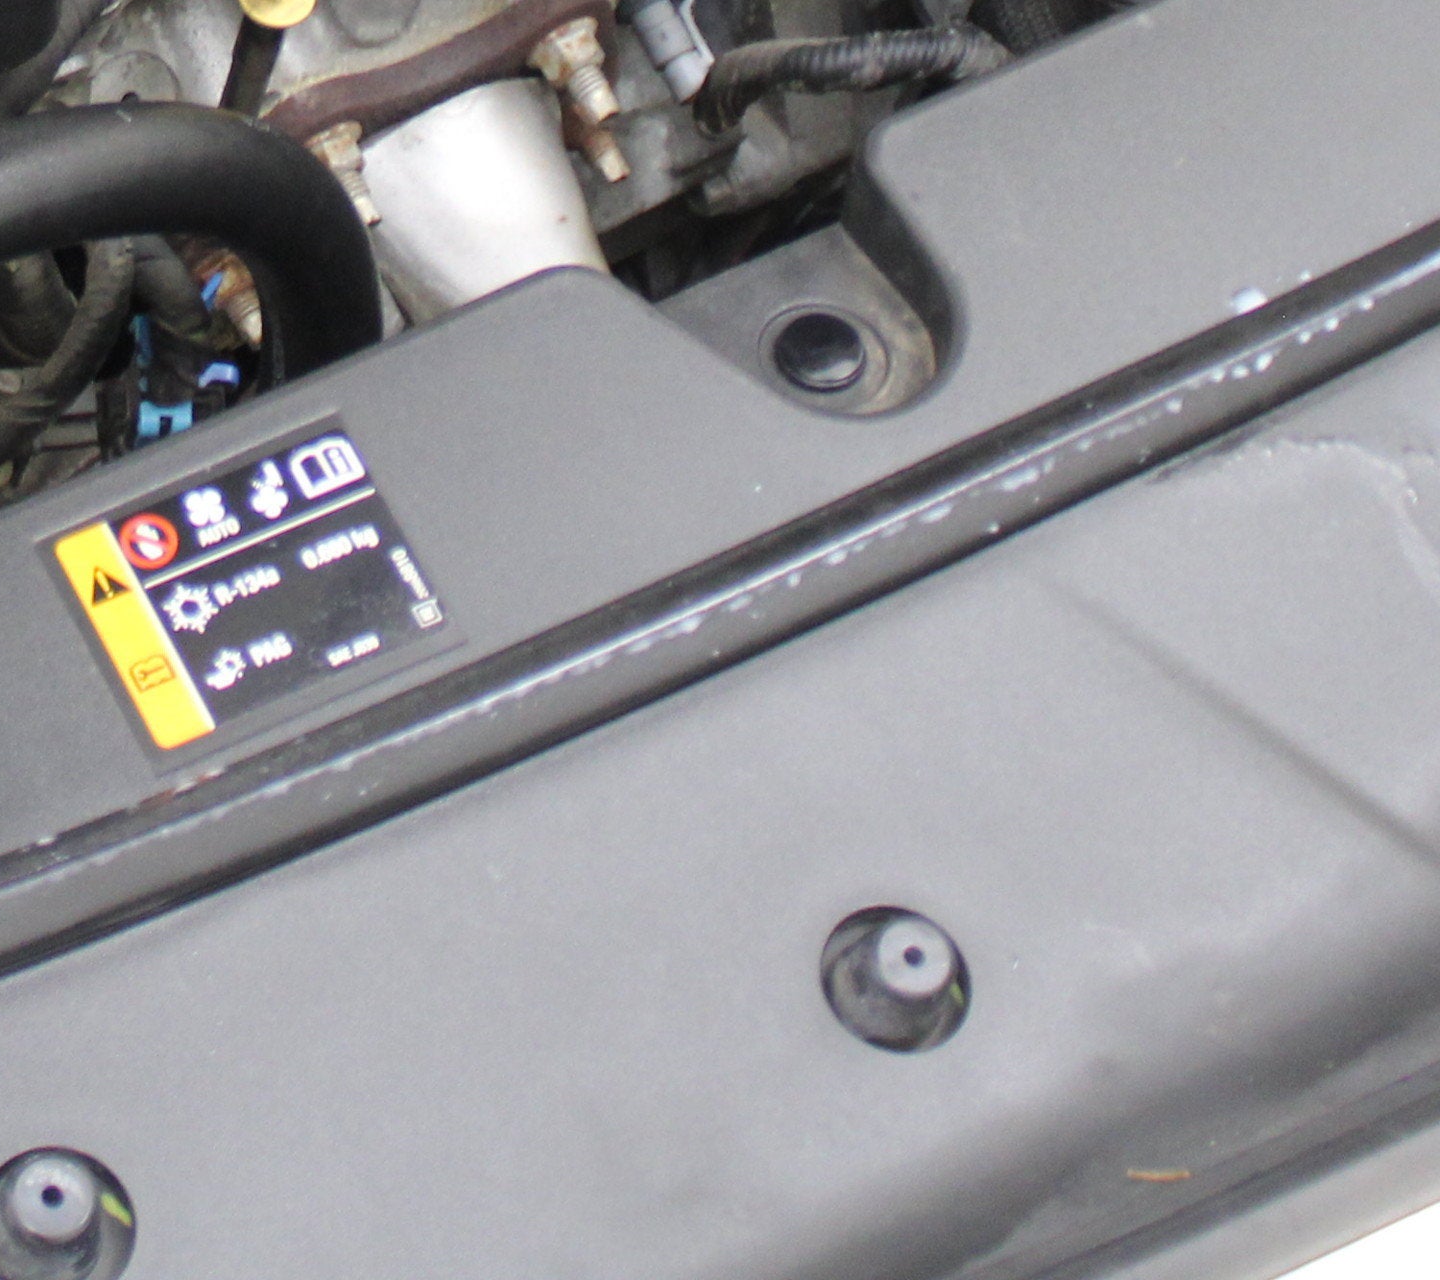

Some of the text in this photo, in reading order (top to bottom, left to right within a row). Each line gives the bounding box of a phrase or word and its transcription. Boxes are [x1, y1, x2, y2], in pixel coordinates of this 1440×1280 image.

[197, 516, 241, 548] AUTO
[213, 566, 281, 607] R-134a
[249, 634, 293, 668] PAG
